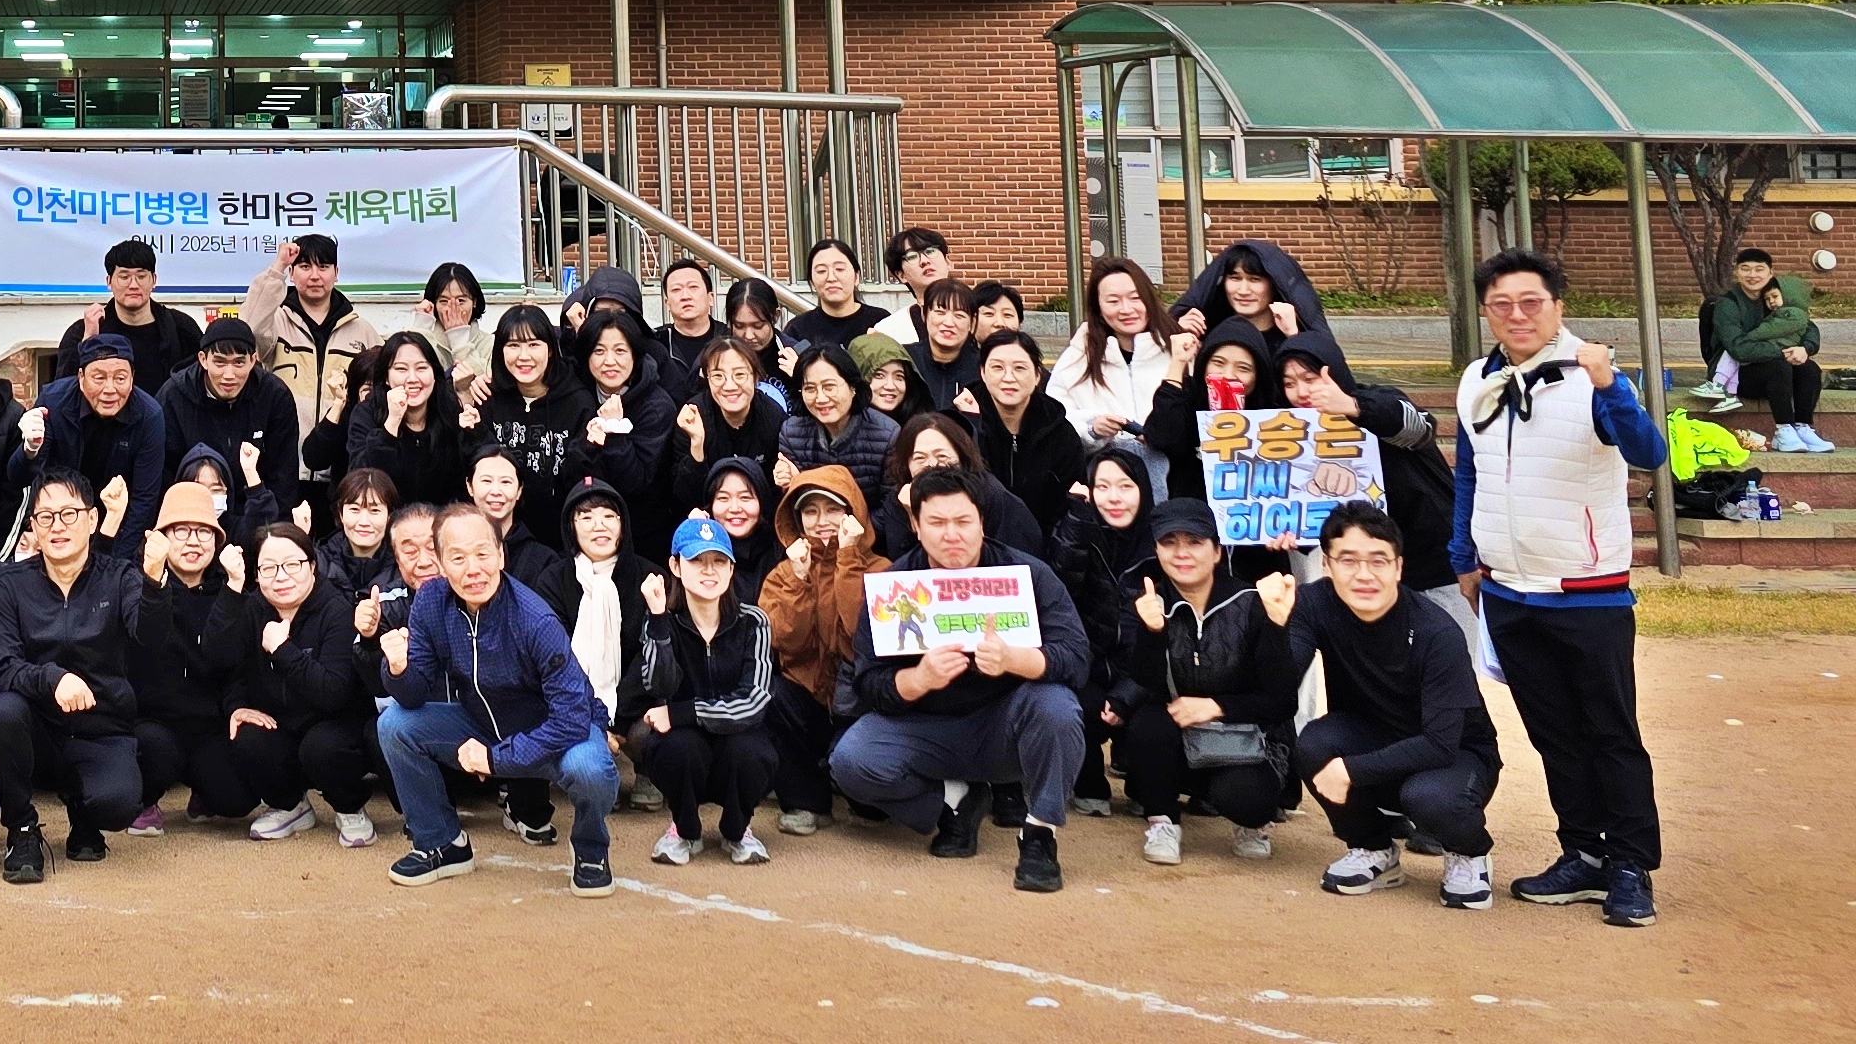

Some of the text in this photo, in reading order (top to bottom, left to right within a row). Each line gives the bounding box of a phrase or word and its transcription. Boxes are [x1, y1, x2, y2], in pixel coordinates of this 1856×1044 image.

[12, 185, 459, 227] 인천마디병원 한마음 체육대회
[180, 234, 236, 254] 2025년
[241, 234, 278, 254] 11월
[1201, 411, 1366, 461] 우승은
[1212, 460, 1292, 500] 디씨
[932, 577, 1019, 601] 긴장해라!
